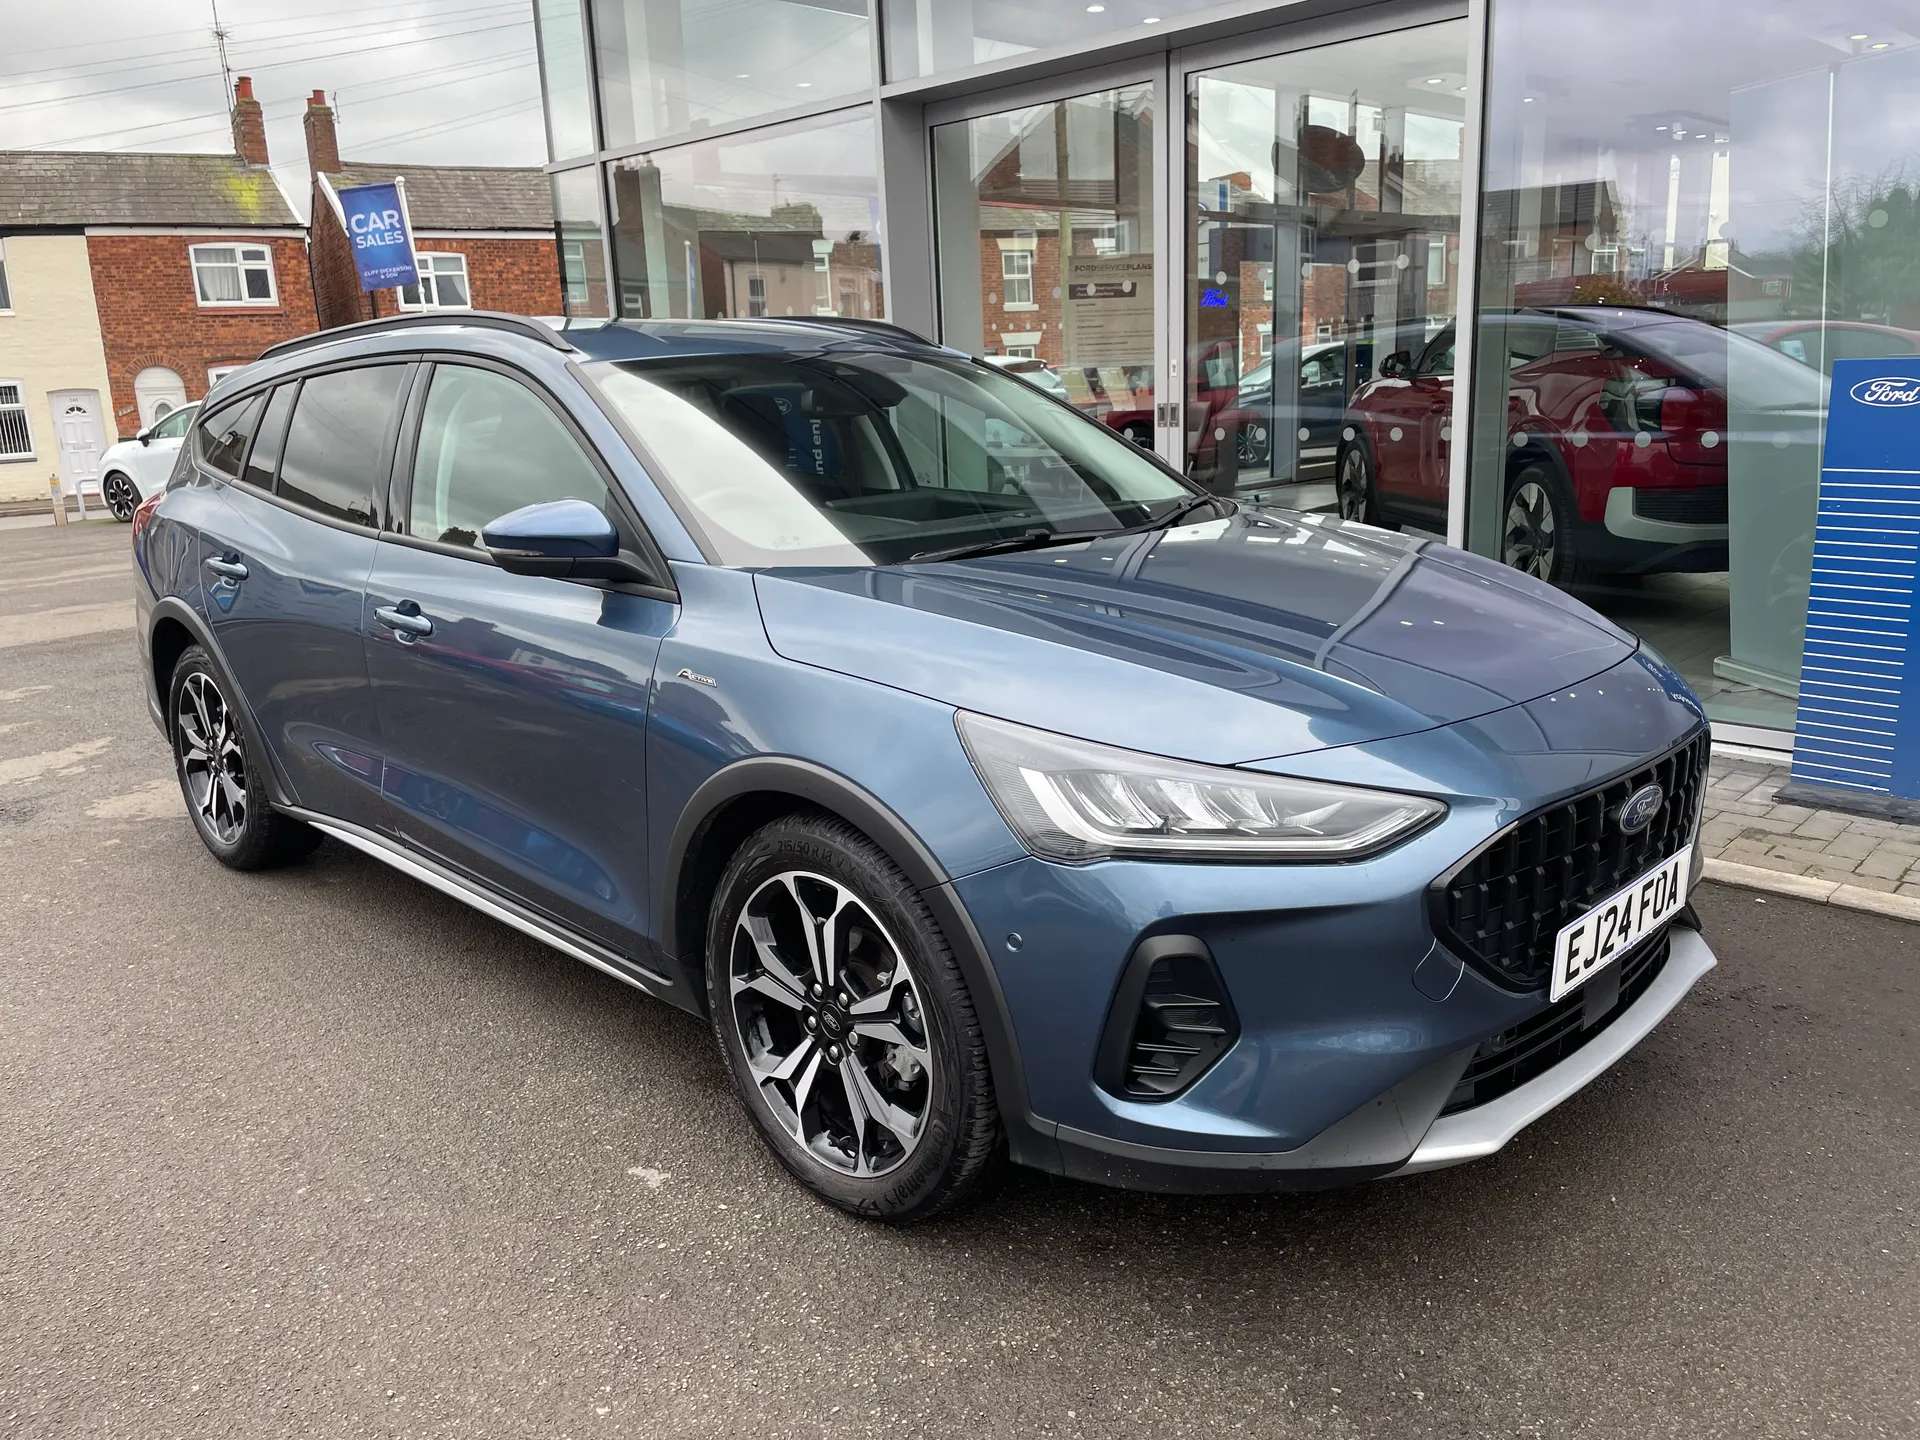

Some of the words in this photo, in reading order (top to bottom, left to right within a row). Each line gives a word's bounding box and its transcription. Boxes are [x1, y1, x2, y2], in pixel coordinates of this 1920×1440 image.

[351, 210, 400, 233] CAR
[356, 231, 404, 248] SALES
[1864, 380, 1920, 402] Ford
[1564, 893, 1633, 985] EJ24
